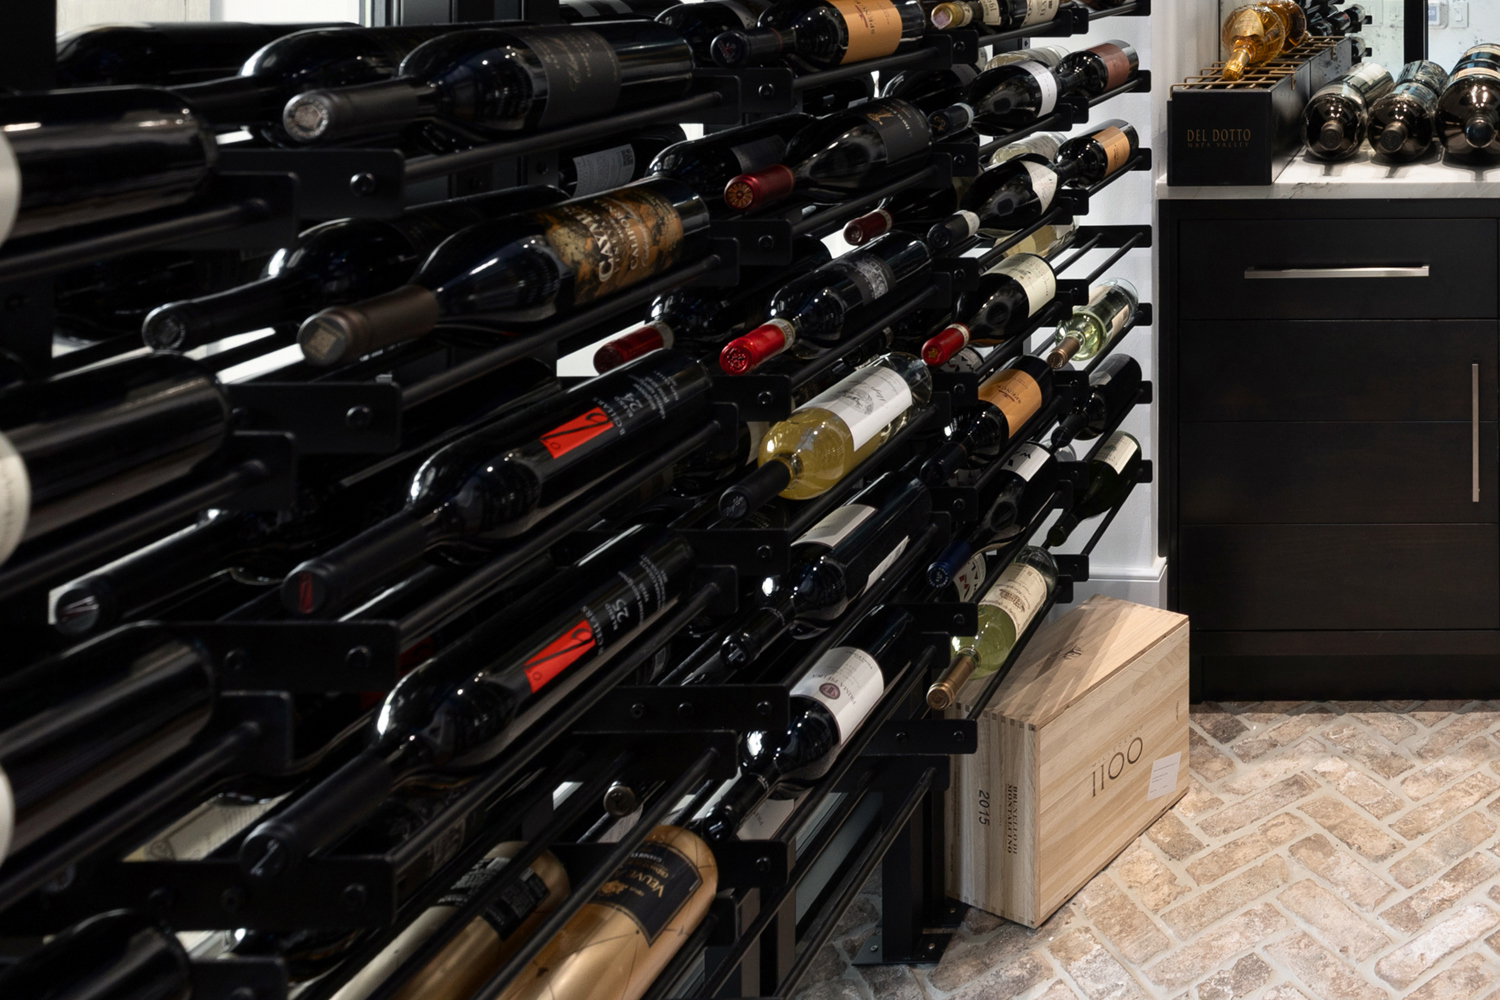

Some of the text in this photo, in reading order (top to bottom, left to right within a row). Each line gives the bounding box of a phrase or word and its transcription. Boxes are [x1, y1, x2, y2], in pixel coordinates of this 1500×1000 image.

[1187, 128, 1251, 142] DEL DOTTO
[592, 397, 622, 428] CELLARS
[614, 395, 634, 418] BLEND
[623, 391, 643, 412] 24
[604, 602, 619, 631] BLEND
[615, 598, 629, 623] 25
[978, 790, 990, 826] 2015
[1012, 843, 1018, 855] DI
